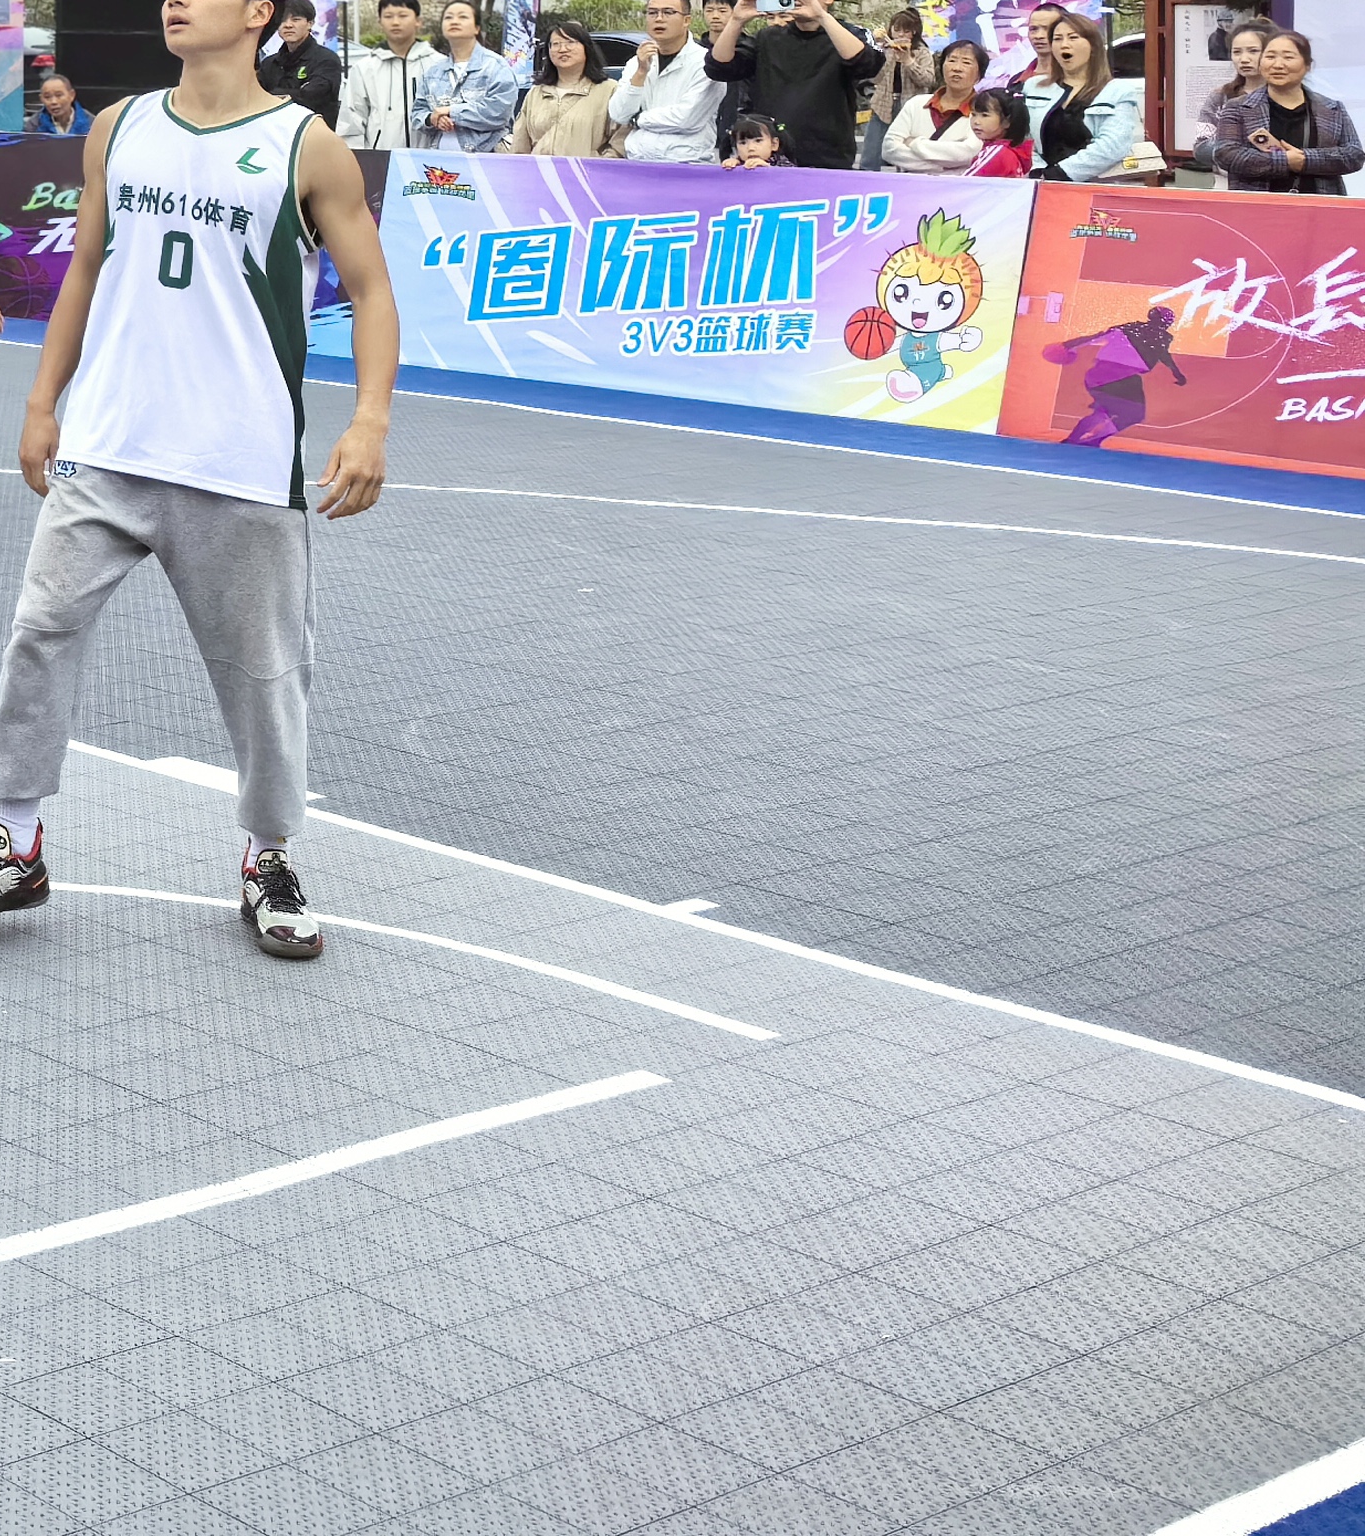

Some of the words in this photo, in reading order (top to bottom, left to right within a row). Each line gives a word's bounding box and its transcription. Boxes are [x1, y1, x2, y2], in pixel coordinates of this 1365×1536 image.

[115, 182, 254, 236] 贵州616体育
[158, 229, 194, 290] 0
[421, 195, 893, 323] “圈际杯”
[622, 311, 816, 357] 3V3篮球赛
